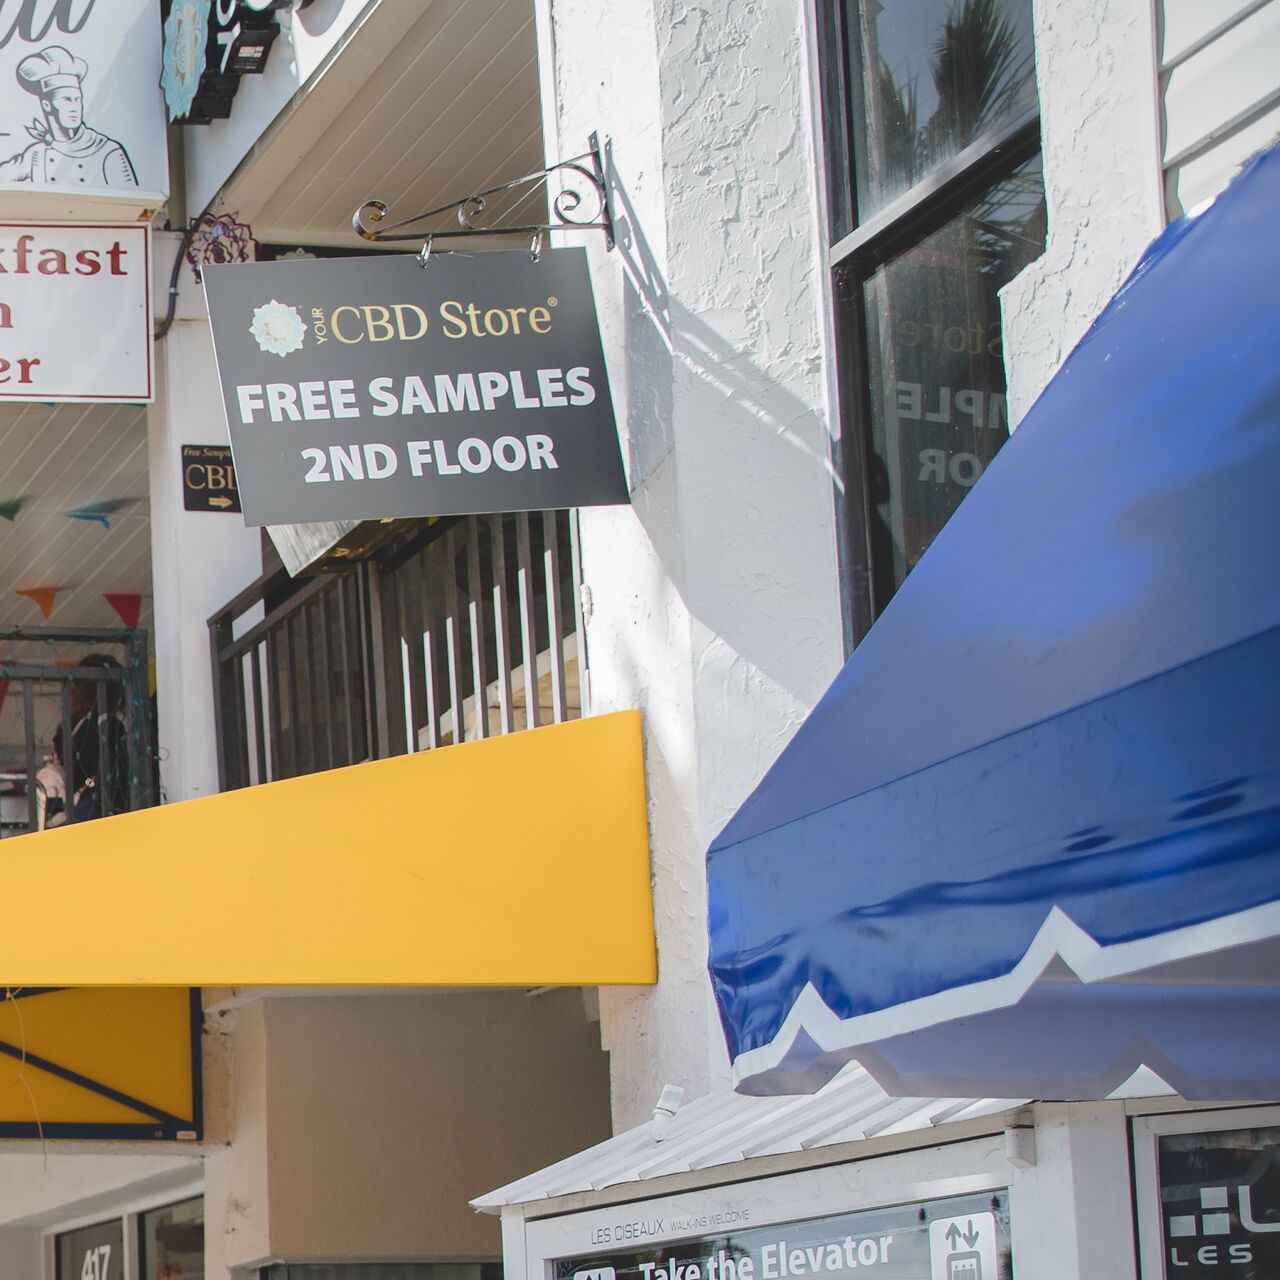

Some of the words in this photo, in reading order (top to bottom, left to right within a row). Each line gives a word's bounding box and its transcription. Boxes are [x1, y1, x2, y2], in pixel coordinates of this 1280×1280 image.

[312, 307, 328, 345] YOUR
[331, 303, 429, 345] CBD
[236, 379, 361, 424] FREE
[368, 367, 596, 417] SAMPLES
[183, 447, 202, 457] Free
[300, 443, 398, 483] 2ND
[406, 434, 559, 477] FLOOR
[591, 1227, 611, 1245] LES
[615, 1218, 665, 1242] CISEAUX
[709, 1209, 750, 1229] WELCOME
[761, 1235, 893, 1280] Elevator
[1171, 1243, 1253, 1267] LES
